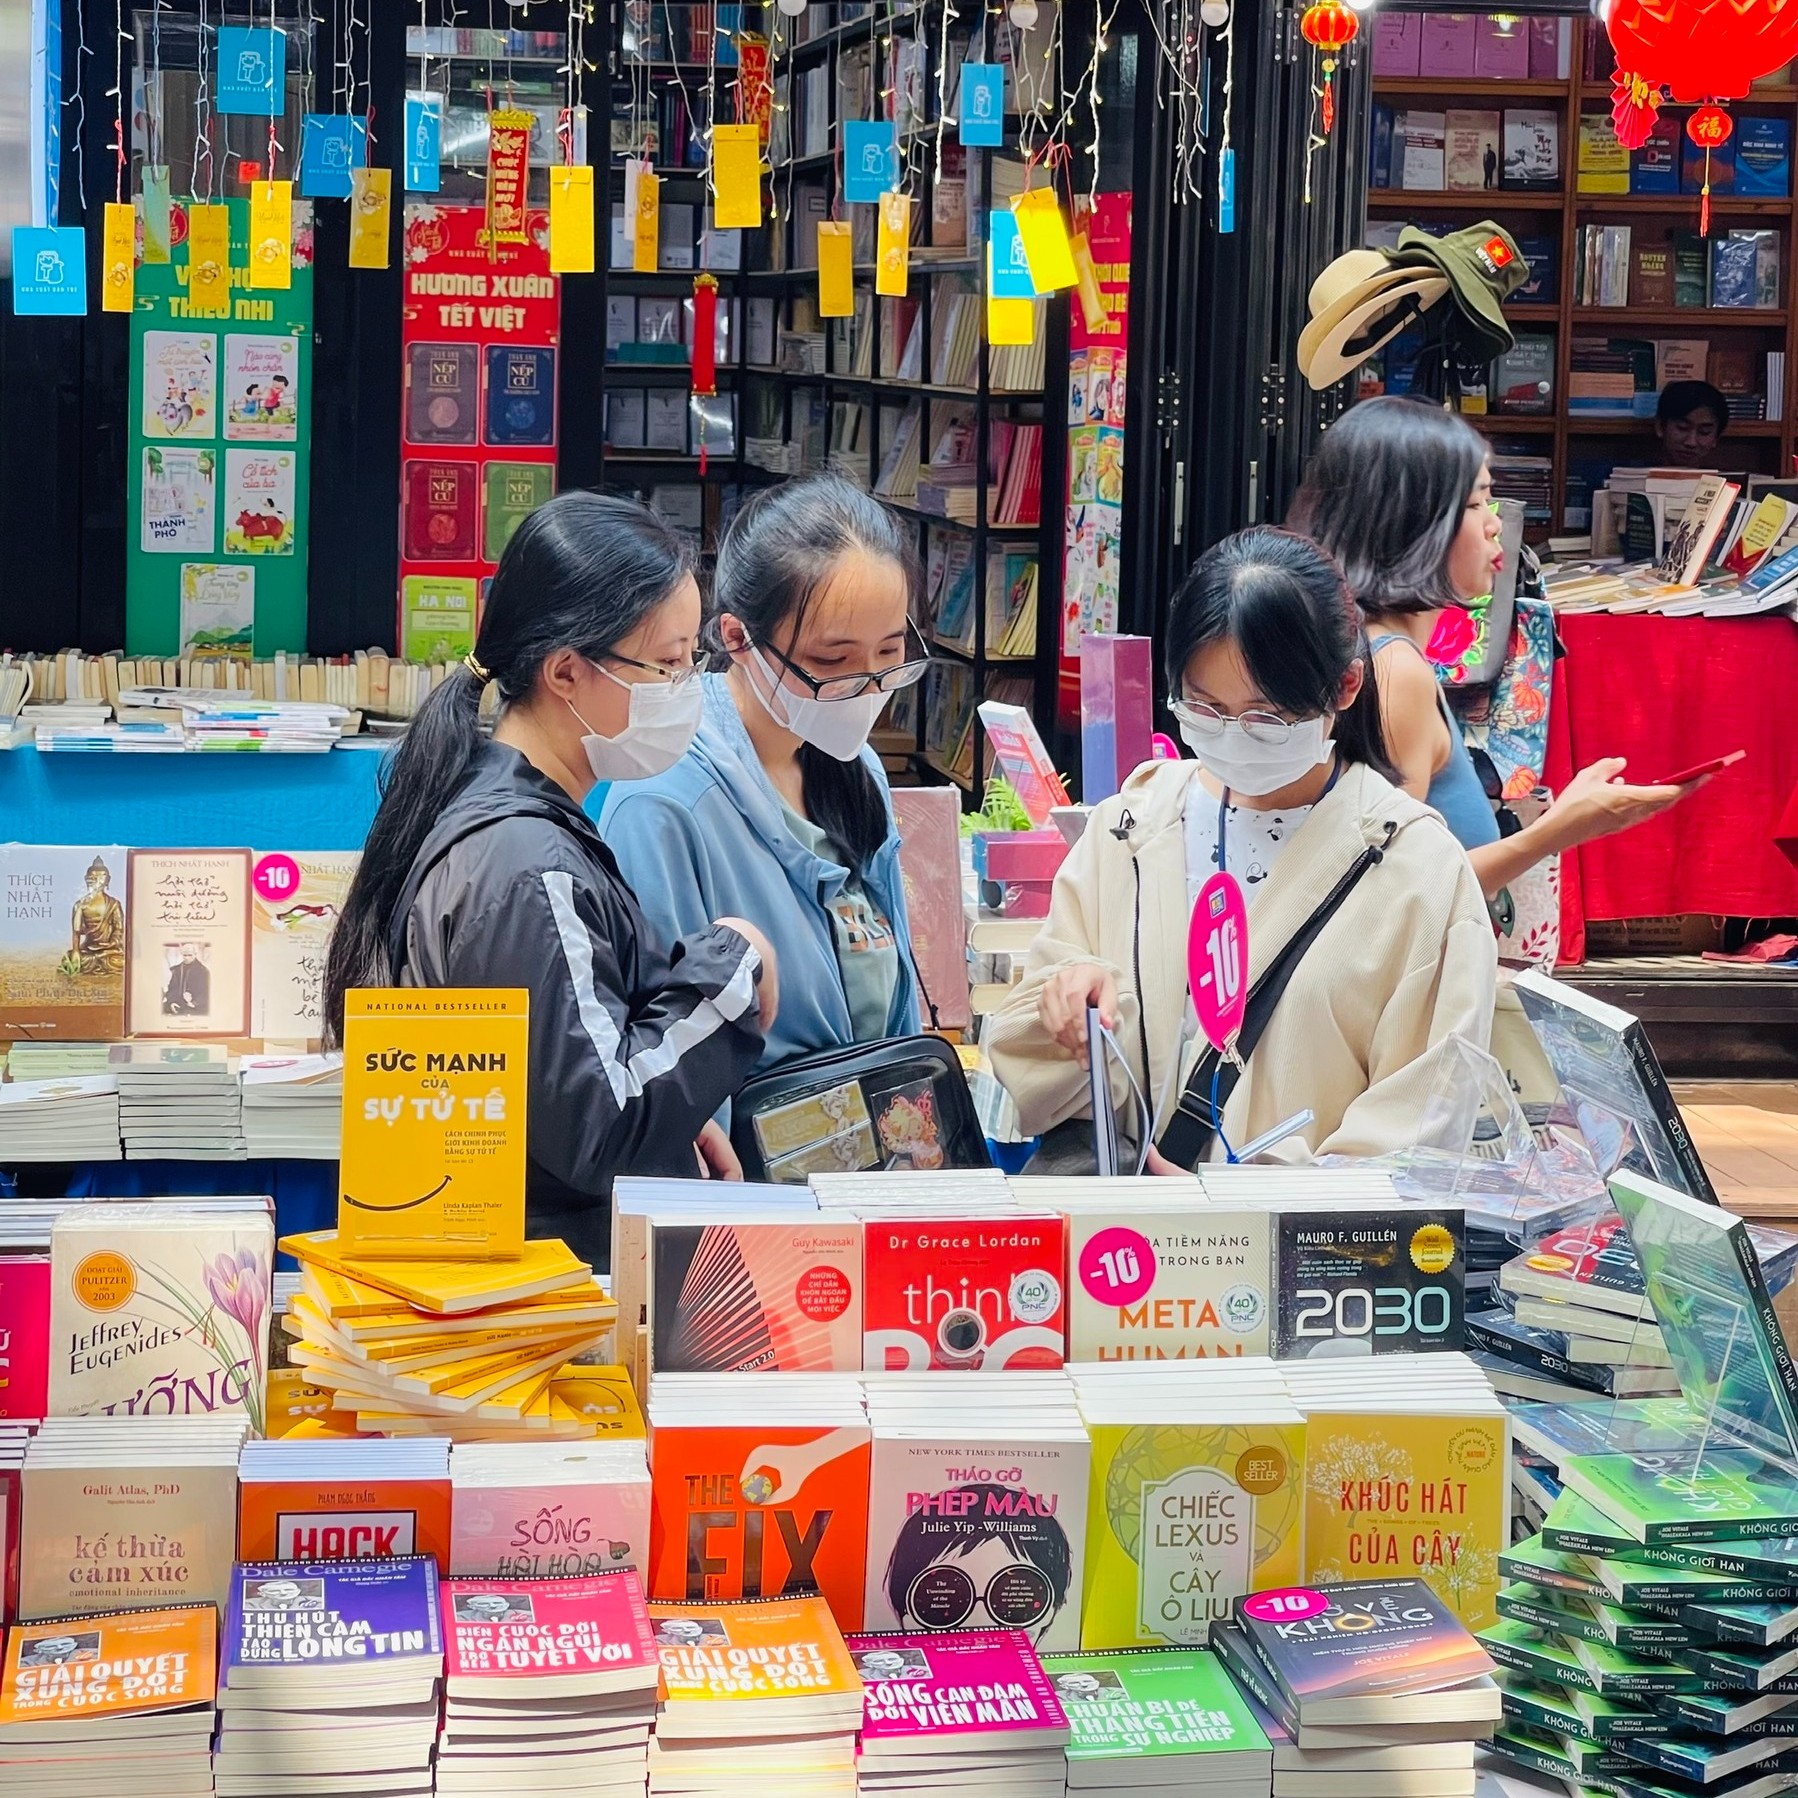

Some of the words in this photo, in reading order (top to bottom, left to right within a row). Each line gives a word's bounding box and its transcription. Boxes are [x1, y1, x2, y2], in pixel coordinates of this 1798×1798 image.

[1697, 116, 1722, 139] 福
[411, 272, 487, 297] HƯƠNG
[491, 273, 554, 299] XUÂN
[235, 298, 274, 321] NHI
[438, 302, 475, 328] TẾT
[479, 304, 526, 332] VIỆT
[6, 906, 53, 921] HẠNH
[1200, 913, 1239, 1010] -10%
[366, 1003, 428, 1011] NATIONAL
[435, 1003, 508, 1011] BESTSELLER
[365, 1047, 418, 1073] SỨC
[425, 1053, 507, 1075] MẠNH
[421, 1075, 450, 1090] CỦA
[363, 1095, 404, 1128] SỰ
[410, 1090, 457, 1122] TỬ
[463, 1086, 507, 1122] TẾ
[1667, 1116, 1689, 1151] 2030
[792, 1238, 811, 1249] Guy
[812, 1237, 854, 1247] Kawasaki
[889, 1235, 909, 1249] Dr
[917, 1234, 970, 1249] Grace
[979, 1233, 1041, 1248] Lordan
[1166, 1233, 1202, 1248] TIỀM
[1207, 1234, 1251, 1247] NĂNG
[1296, 1232, 1334, 1244] MAURO
[1338, 1231, 1348, 1244] F.
[1352, 1228, 1398, 1243] GUILLÉN
[1089, 1245, 1141, 1288] -10%
[1160, 1256, 1210, 1266] TRONG
[1216, 1255, 1245, 1268] BẠN
[81, 1275, 128, 1285] PULITZER
[810, 1271, 837, 1280] NHỮNG
[92, 1292, 116, 1301] 2003
[1024, 1286, 1041, 1298] 40
[1021, 1302, 1047, 1311] PNC
[1234, 1298, 1250, 1309] 40
[1296, 1286, 1451, 1337] 2030
[1119, 1299, 1221, 1329] META
[1230, 1314, 1256, 1322] PNC
[738, 1354, 762, 1372] Start
[761, 1350, 776, 1362] 2.0
[1540, 1353, 1569, 1373] 2030
[908, 1448, 933, 1457] NEW
[935, 1448, 963, 1457] YORK
[966, 1449, 996, 1457] TIMES
[997, 1450, 1061, 1459] BESTSELLER
[1248, 1459, 1274, 1471] BEST
[945, 1467, 992, 1483] THÁO
[995, 1466, 1023, 1483] GỠ
[1243, 1470, 1279, 1482] SELLER
[82, 1484, 113, 1496] Galit
[116, 1484, 150, 1497] Atlas,
[153, 1484, 181, 1496] PhD
[684, 1474, 735, 1506] THE
[1340, 1475, 1409, 1514] KHÚC
[1420, 1477, 1468, 1514] HÁT
[906, 1487, 980, 1518] PHÉP
[983, 1485, 1059, 1518] MÀU
[1161, 1490, 1236, 1519] CHIẾC
[510, 1504, 592, 1547] SỐNG
[920, 1521, 951, 1536] Julie
[952, 1521, 976, 1536] Yip
[1740, 1522, 1778, 1535] KHÔNG
[291, 1525, 401, 1560] HACK
[1155, 1523, 1239, 1548] LEXUS
[75, 1532, 110, 1559] kế
[116, 1533, 186, 1559] thừa
[686, 1509, 834, 1600] FIX
[1349, 1526, 1400, 1565] CỦA
[1412, 1528, 1462, 1567] CÂY
[497, 1547, 541, 1576] HÀI
[548, 1545, 602, 1575] HÒA
[1189, 1549, 1205, 1563] VÀ
[1644, 1549, 1686, 1564] KHÔNG
[68, 1559, 131, 1584] cảm
[139, 1560, 189, 1584] xúc
[239, 1567, 299, 1578] Dale
[303, 1561, 412, 1577] Carnegie
[1169, 1567, 1222, 1594] CÂY
[68, 1587, 122, 1598] emotional
[125, 1586, 187, 1598] inheritance
[1722, 1586, 1763, 1598] KHÔNG
[242, 1611, 288, 1625] THU
[295, 1609, 340, 1624] HÚT
[1160, 1594, 1183, 1622] Ô
[1190, 1597, 1229, 1621] LIU
[316, 1619, 372, 1637] CẢM
[557, 1620, 599, 1635] ĐỜI
[1274, 1607, 1435, 1639] KHÔNG
[282, 1634, 367, 1659] LÒNG
[370, 1630, 425, 1653] TIN
[582, 1642, 633, 1664] VỜI
[664, 1664, 754, 1681] XUNG
[14, 1677, 111, 1703] XUNG
[863, 1680, 934, 1707] SỐNG
[933, 1686, 977, 1704] CAN
[976, 1681, 1029, 1701] ĐẢM
[867, 1703, 909, 1722] ĐỜI
[908, 1701, 975, 1727] VIÊN
[1073, 1733, 1120, 1745] TRONG
